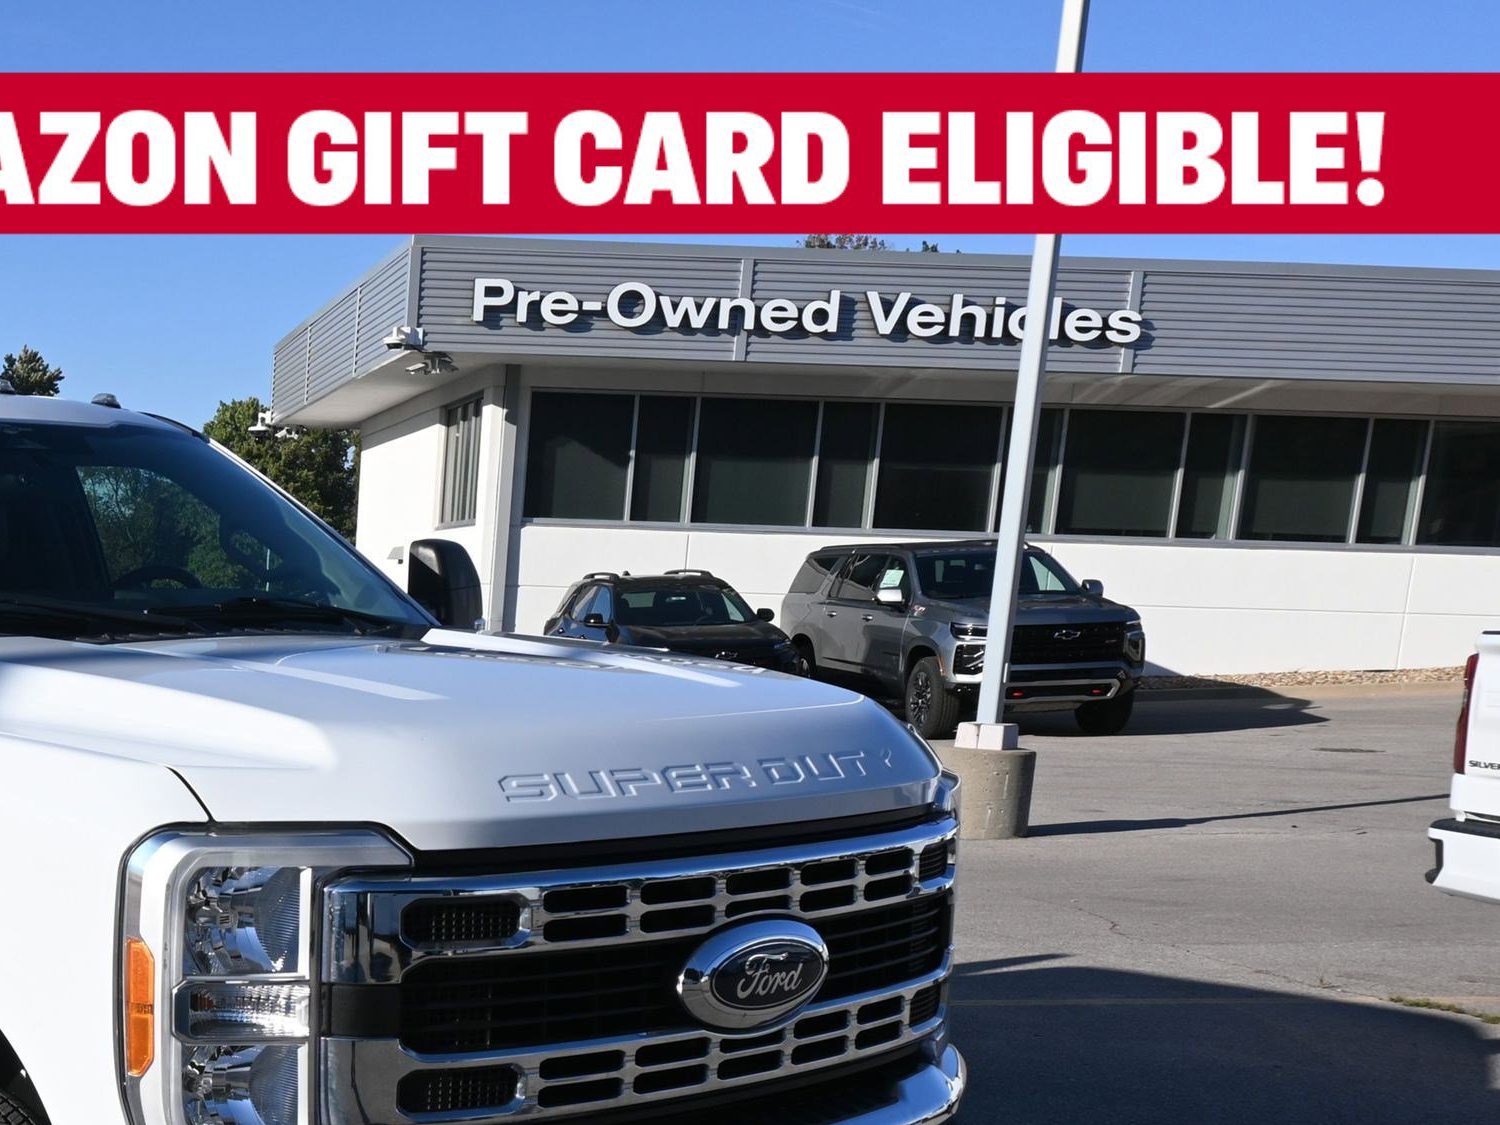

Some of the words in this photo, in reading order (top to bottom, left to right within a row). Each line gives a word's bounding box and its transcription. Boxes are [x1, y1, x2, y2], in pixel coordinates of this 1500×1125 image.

[473, 278, 841, 333] Pre-Owned
[497, 762, 757, 803] SUPER
[736, 951, 803, 999] Ford
